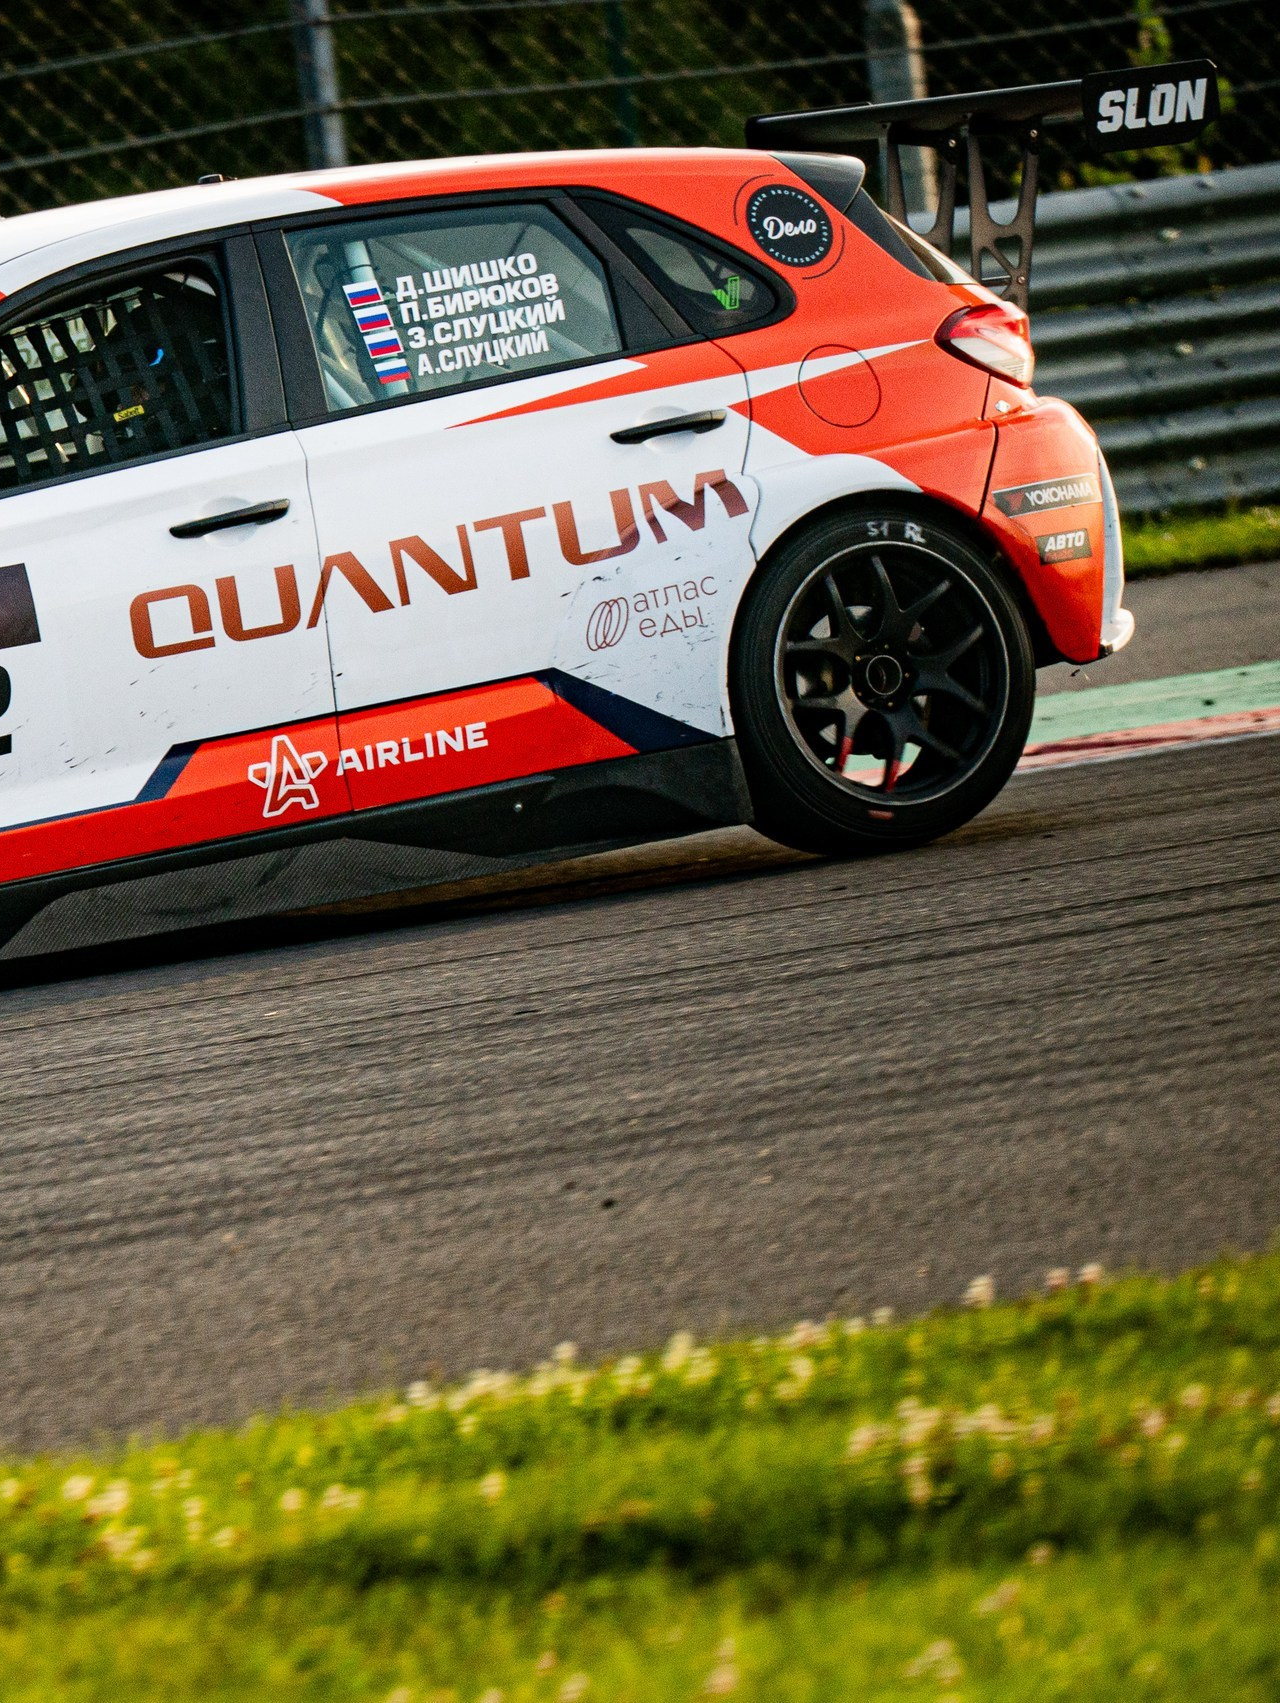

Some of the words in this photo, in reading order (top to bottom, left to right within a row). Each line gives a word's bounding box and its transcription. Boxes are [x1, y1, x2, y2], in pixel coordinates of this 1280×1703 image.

[1097, 78, 1207, 133] SLON
[762, 216, 817, 240] Дело
[395, 253, 538, 302] Д.ШИШКО
[399, 273, 559, 324] П.БИРЮКОВ
[407, 294, 566, 349] З.СЛУЦКИЙ
[418, 325, 550, 376] А.СЛУЦКИЙ
[1025, 481, 1095, 507] YOKOHAMA
[129, 468, 750, 659] QUANTUM
[1044, 530, 1085, 552] АВТО
[632, 576, 718, 613] атлас
[639, 606, 704, 637] еды
[336, 721, 489, 776] AIRLINE
